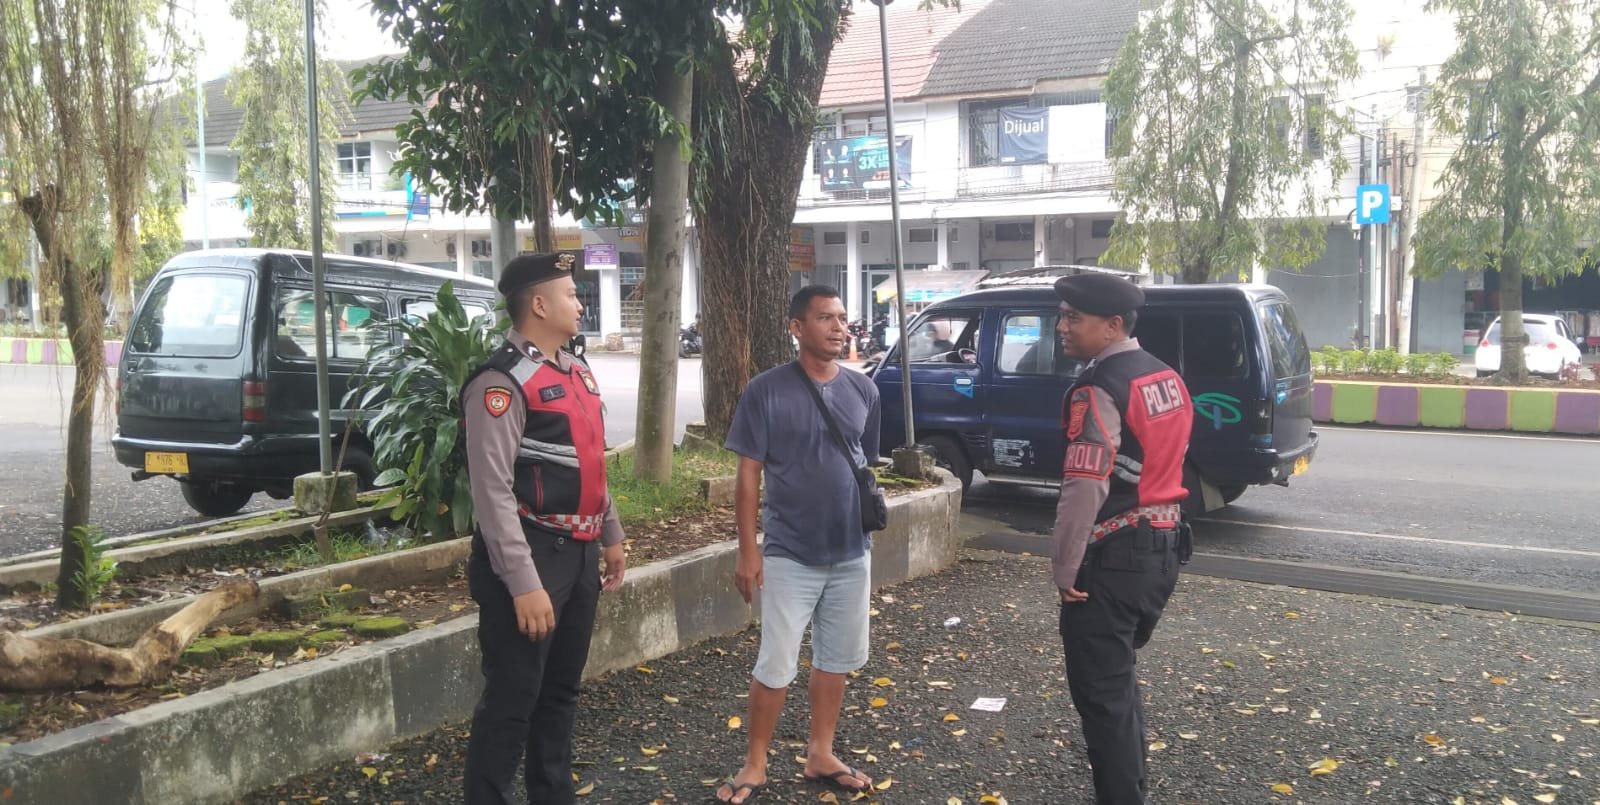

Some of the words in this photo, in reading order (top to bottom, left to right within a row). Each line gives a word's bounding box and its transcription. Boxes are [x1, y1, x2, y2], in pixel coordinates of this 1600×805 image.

[1005, 117, 1044, 137] Dijual
[858, 155, 877, 170] 3X
[1362, 190, 1384, 219] P
[1142, 377, 1184, 417] POLISI
[1064, 443, 1106, 472] ROLI
